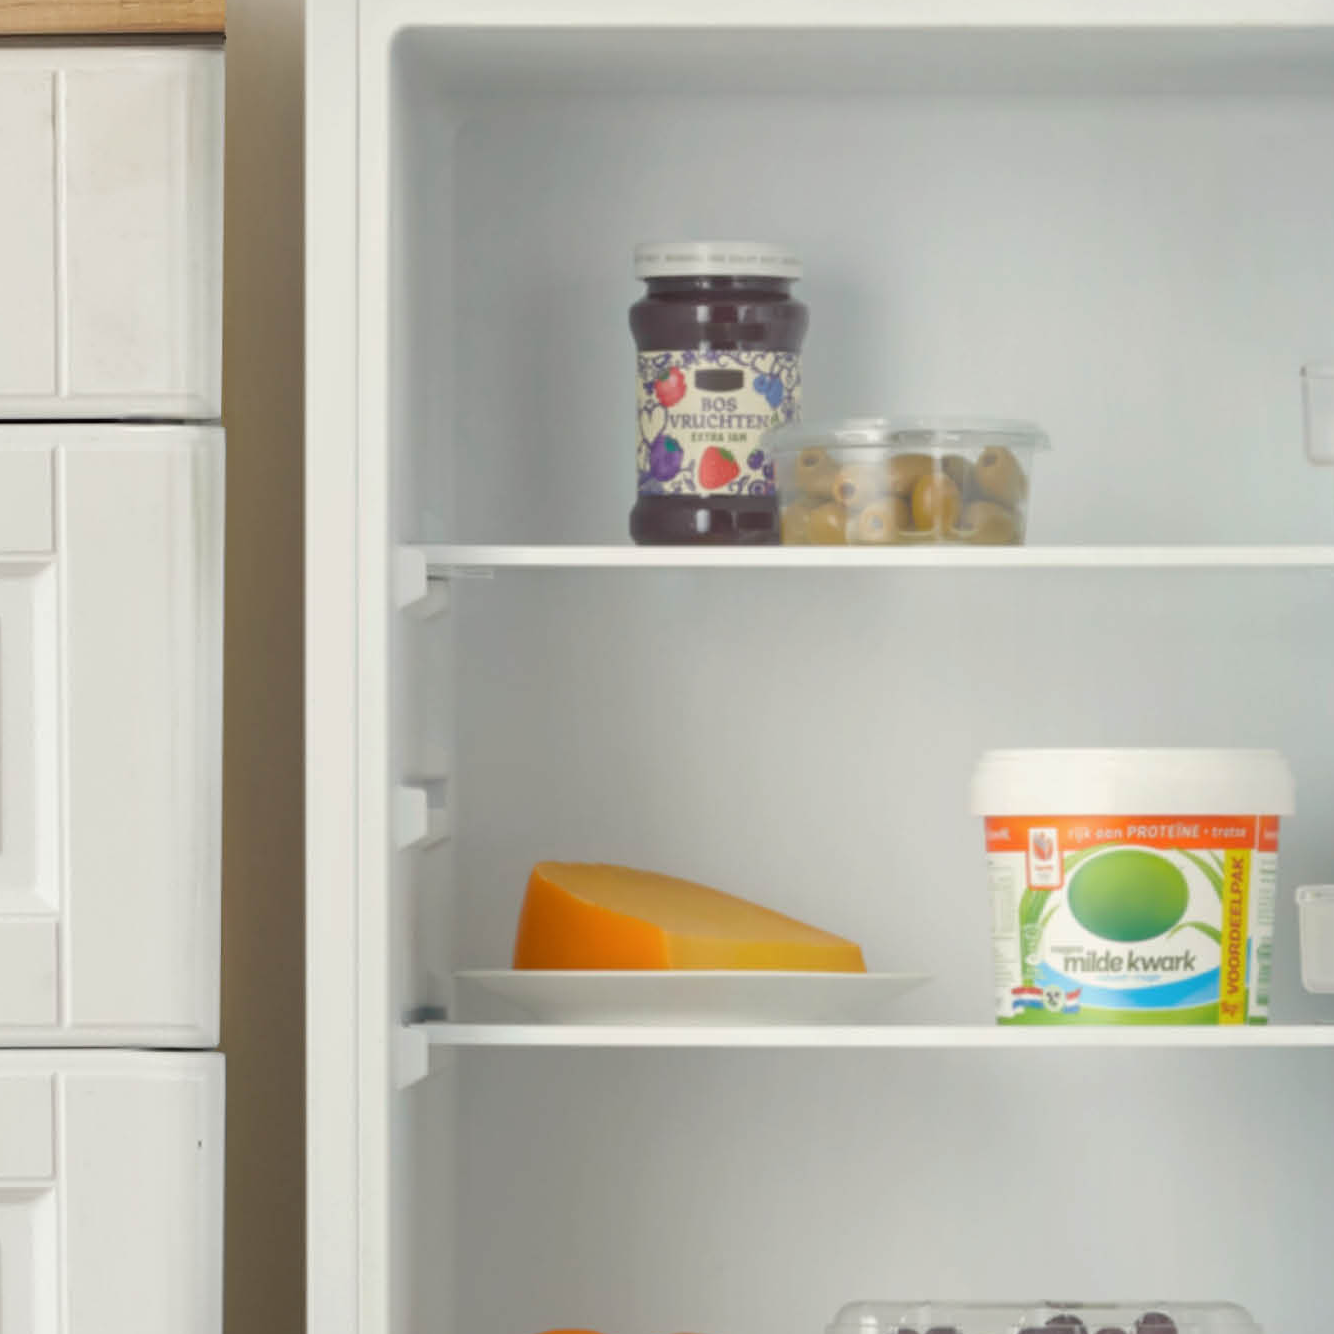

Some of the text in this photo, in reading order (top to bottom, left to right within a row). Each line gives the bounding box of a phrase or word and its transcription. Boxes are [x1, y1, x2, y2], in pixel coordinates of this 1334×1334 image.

[701, 397, 738, 412] BOS
[670, 413, 772, 430] VRUCHTEN
[1126, 823, 1200, 838] PROTEÏNE
[1227, 856, 1244, 995] VOORDEELPAK
[1064, 948, 1197, 972] milde kwark
